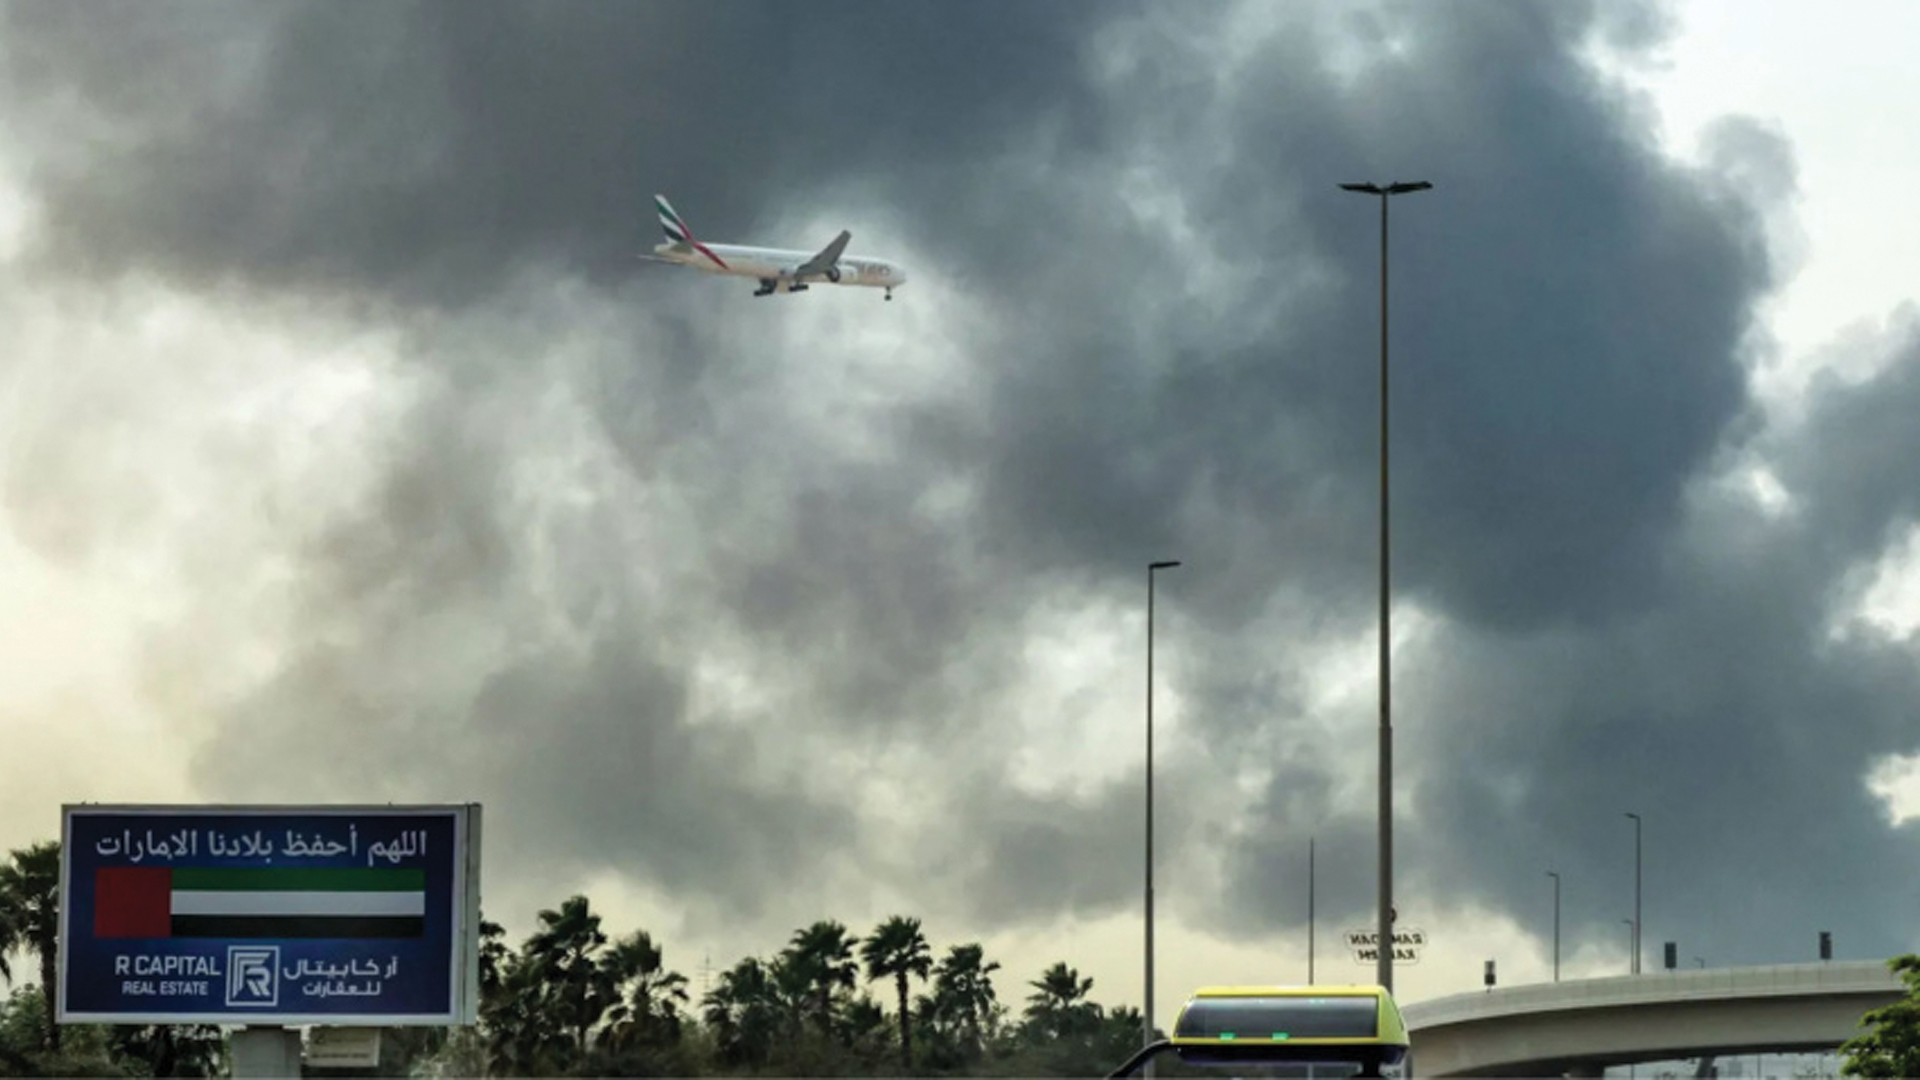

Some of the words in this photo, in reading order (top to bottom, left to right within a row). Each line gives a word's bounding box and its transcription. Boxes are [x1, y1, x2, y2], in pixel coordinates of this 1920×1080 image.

[207, 829, 273, 864] بلادنا
[282, 823, 358, 857] أحفظ
[367, 830, 427, 867] اللهم
[115, 956, 130, 976] R
[134, 956, 222, 976] CAPITAL
[122, 981, 156, 996] REAL
[159, 981, 209, 996] ESTATE
